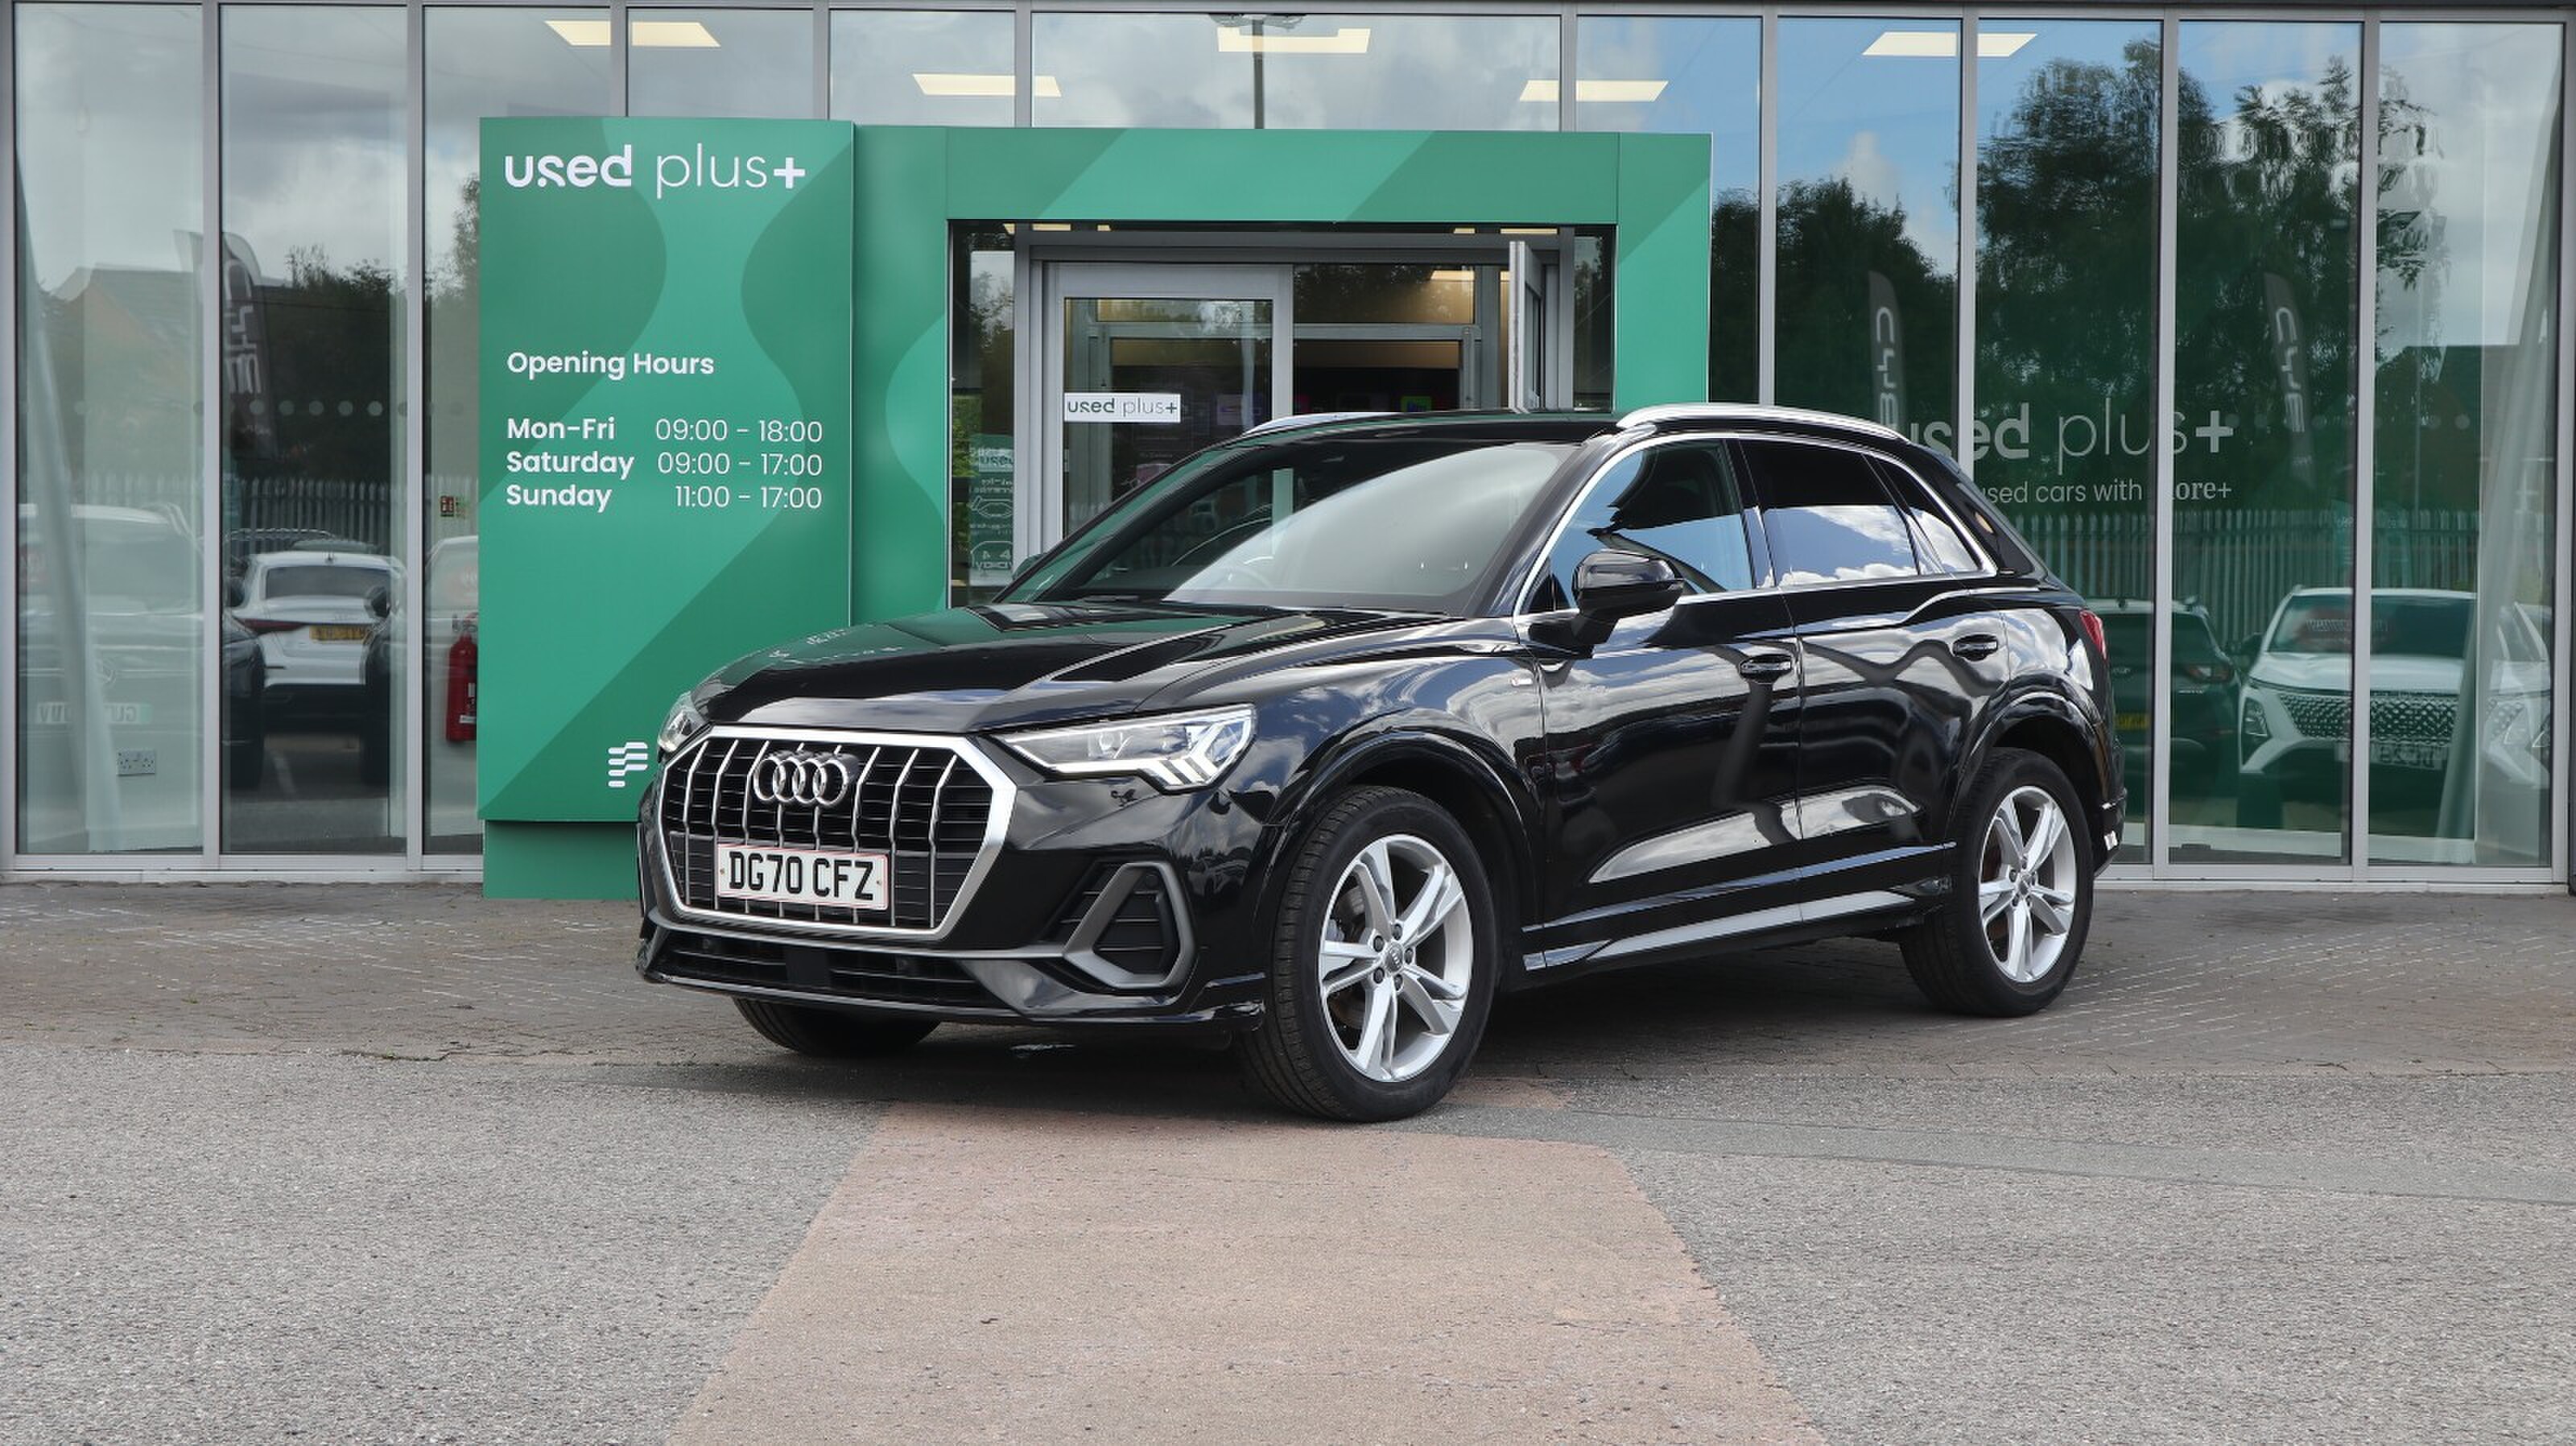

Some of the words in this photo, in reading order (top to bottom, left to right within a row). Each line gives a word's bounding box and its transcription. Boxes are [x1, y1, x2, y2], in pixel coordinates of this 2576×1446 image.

[505, 144, 632, 188] used
[656, 143, 806, 200] plus+
[507, 350, 625, 381] Opening
[634, 353, 715, 374] Hours
[1068, 398, 1115, 413] used
[1123, 397, 1178, 417] plus+
[508, 416, 615, 440] Mon-Fri
[655, 419, 728, 440] 09:00
[759, 419, 823, 442] 18:00
[507, 450, 635, 480] Saturday
[658, 452, 730, 474] 09:00
[761, 453, 822, 476] 17:00
[506, 484, 613, 513] Sunday
[675, 485, 730, 507] 11:00
[761, 486, 822, 509] 17:00
[2035, 485, 2087, 503] cars
[2093, 478, 2142, 502] with
[2174, 482, 2232, 500] ore+
[729, 851, 803, 894] DG70
[813, 857, 873, 901] CFZ
